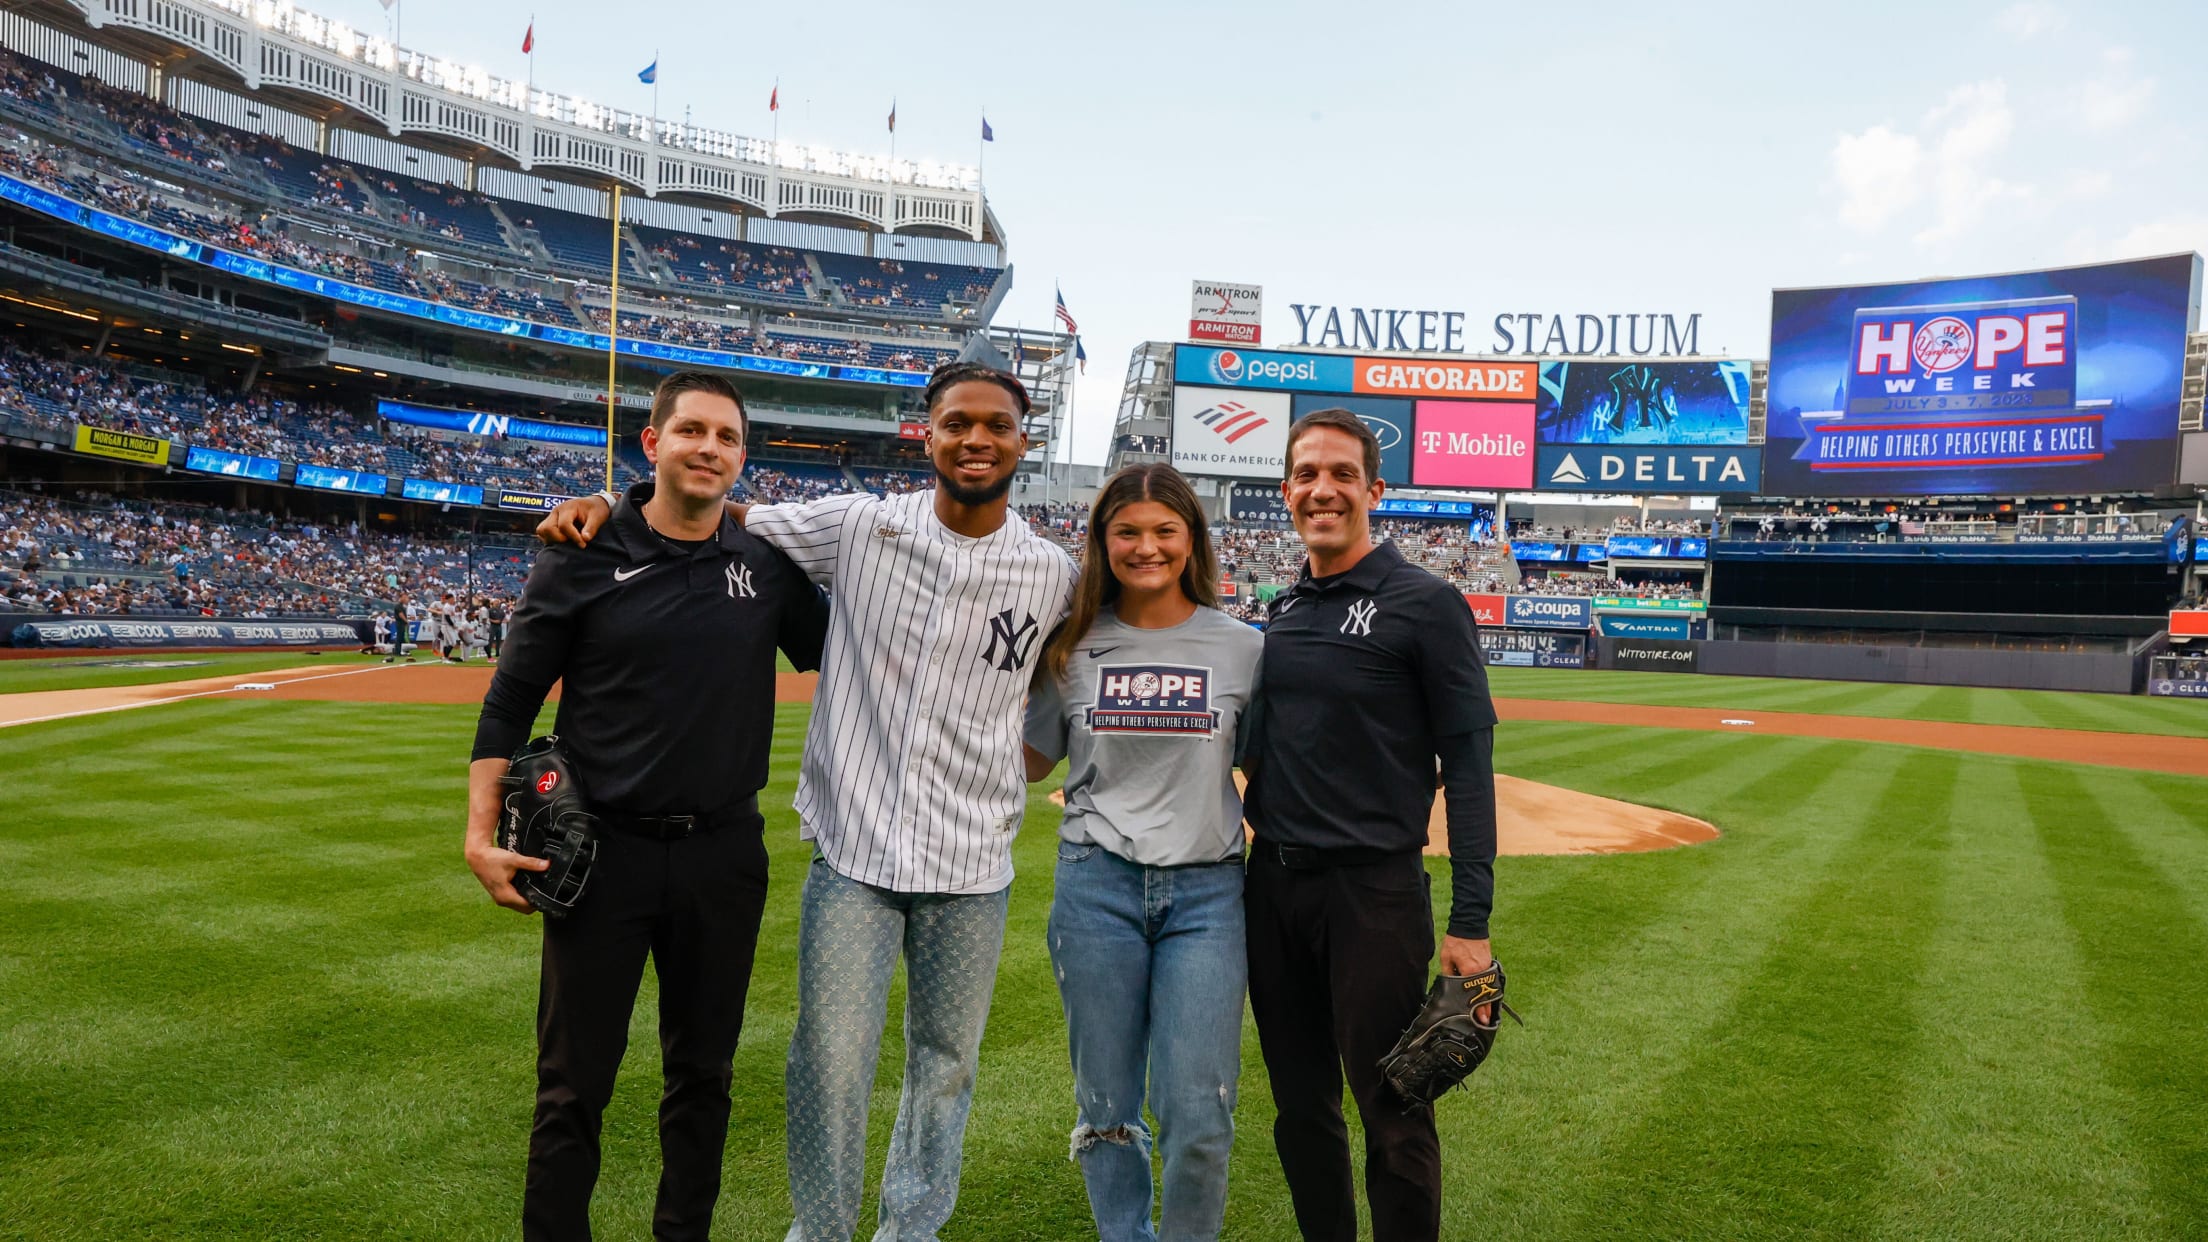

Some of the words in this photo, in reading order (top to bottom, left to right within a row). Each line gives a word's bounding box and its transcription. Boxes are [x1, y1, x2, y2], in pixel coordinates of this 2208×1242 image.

[1195, 286, 1260, 300] ARMITRON
[1196, 323, 1255, 335] ARMITRON
[1290, 304, 1466, 353] YANKEE
[1492, 312, 1702, 356] STADIUM
[1856, 311, 2067, 375] HOPE
[1248, 359, 1316, 384] pepsi
[1366, 364, 1525, 393] GATORADE
[1884, 373, 2036, 394] WEEK
[624, 396, 654, 409] YANKEE
[1883, 398, 1930, 410] JULY
[94, 430, 122, 447] MORGAN
[122, 436, 129, 448] &
[129, 438, 156, 452] MORGAN
[1448, 432, 1526, 458] Mobile
[1820, 433, 1878, 459] HELPING
[1885, 431, 1938, 457] OTHERS
[1945, 428, 2028, 455] PERSEVERE
[2033, 430, 2043, 452] &
[2050, 426, 2096, 451] EXCEL
[1174, 451, 1208, 462] BANK
[1212, 454, 1227, 464] OF
[1230, 454, 1284, 467] AMERICA
[1600, 456, 1746, 482] DELTA
[502, 495, 544, 506] ARMITRON
[725, 560, 757, 598] NY
[1340, 598, 1378, 637] NY
[1534, 602, 1581, 619] coupa
[70, 624, 108, 640] COOL
[136, 624, 168, 638] COOL
[194, 626, 222, 638] COOL
[252, 628, 278, 639] COOL
[298, 628, 320, 639] COOL
[981, 608, 1039, 672] NY
[1554, 657, 1580, 665] CLEAR
[1618, 648, 1692, 662] NITTOTIRE.COM
[1105, 672, 1202, 700] HOPE
[2180, 684, 2208, 693] CLEA
[1117, 698, 1190, 708] WEEK
[1095, 714, 1120, 727] HELPING
[1122, 716, 1145, 728] OTHERS
[1148, 716, 1182, 728] PERSEVERE
[1190, 717, 1208, 730] EXCEL
